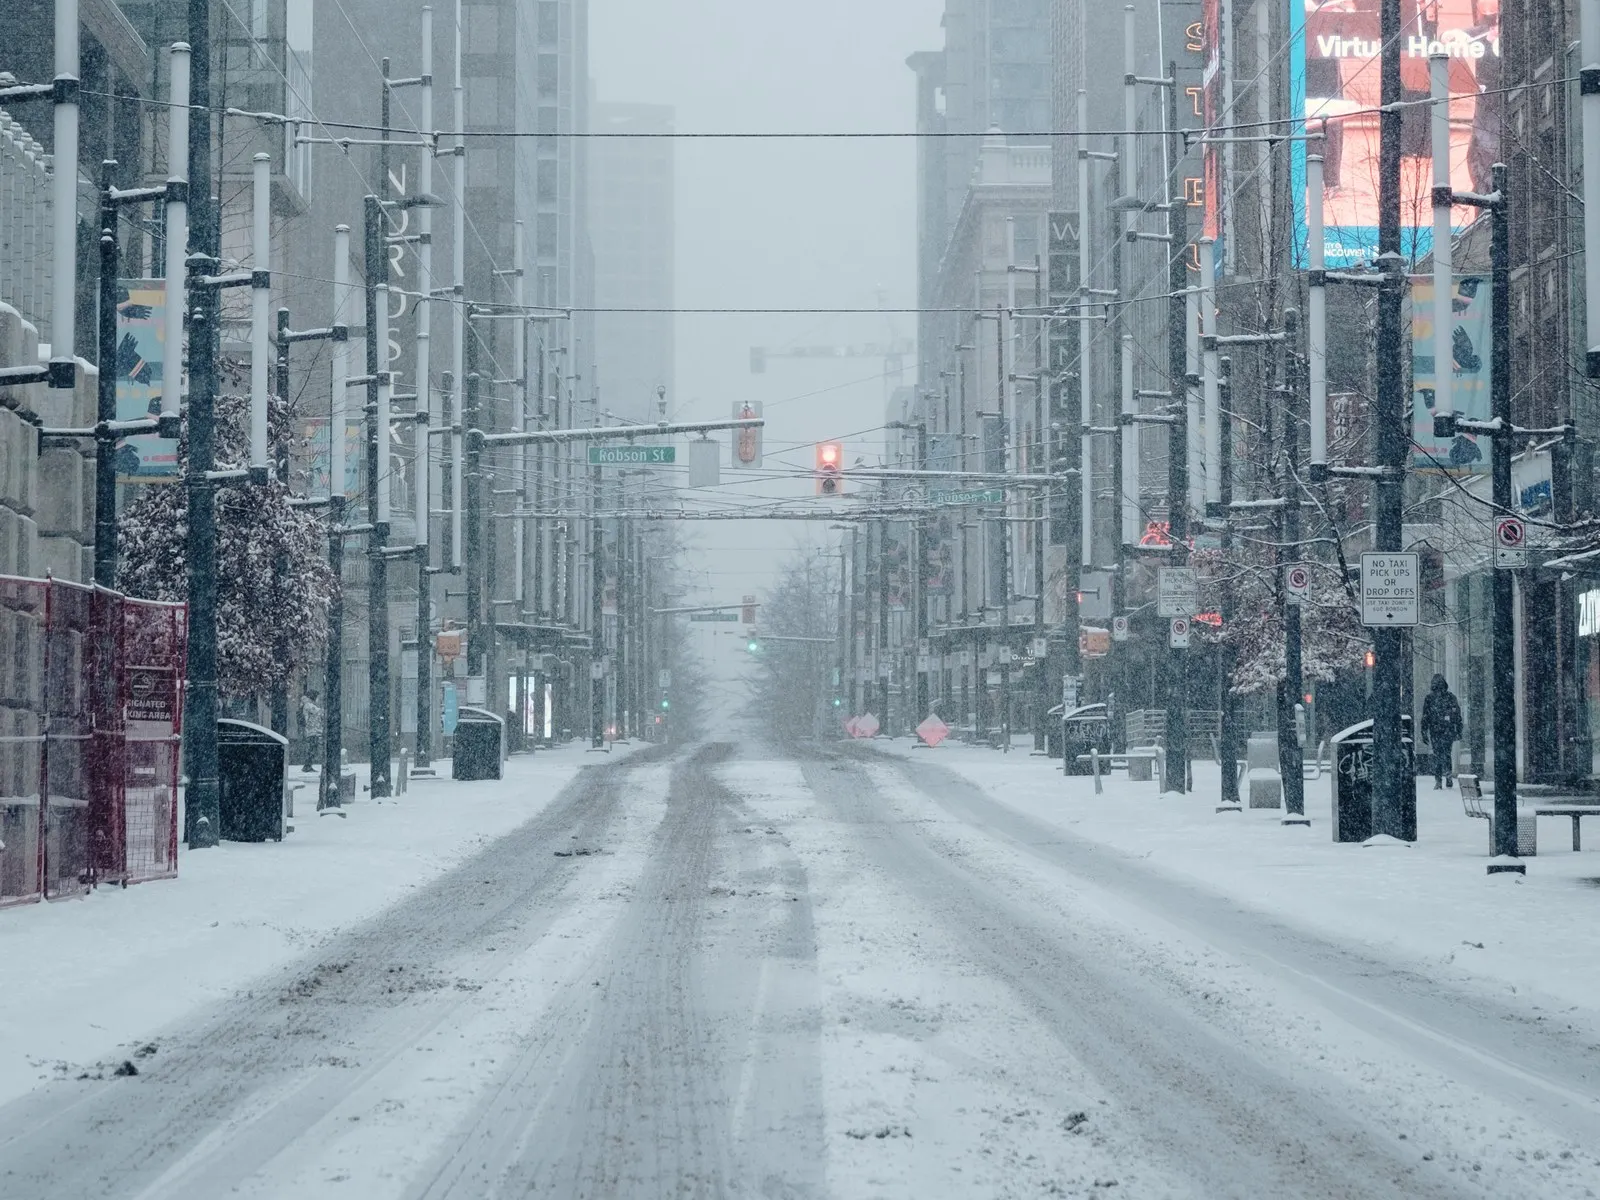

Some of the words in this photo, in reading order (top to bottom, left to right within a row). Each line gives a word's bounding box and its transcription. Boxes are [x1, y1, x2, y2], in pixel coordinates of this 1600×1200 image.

[1316, 35, 1382, 58] Virtu
[1324, 248, 1366, 258] NCOUVER
[599, 448, 648, 462] Robson
[652, 448, 666, 462] St
[1372, 560, 1386, 568] NO
[1389, 560, 1408, 568] TAXI
[1370, 569, 1390, 577] PICK
[1394, 569, 1411, 577] UPS
[1384, 578, 1396, 587] OR
[1366, 588, 1390, 596] DROP
[1393, 588, 1415, 596] OFFS
[126, 699, 167, 709] SIGNATED
[127, 710, 147, 719] KING
[148, 711, 171, 720] AREA
